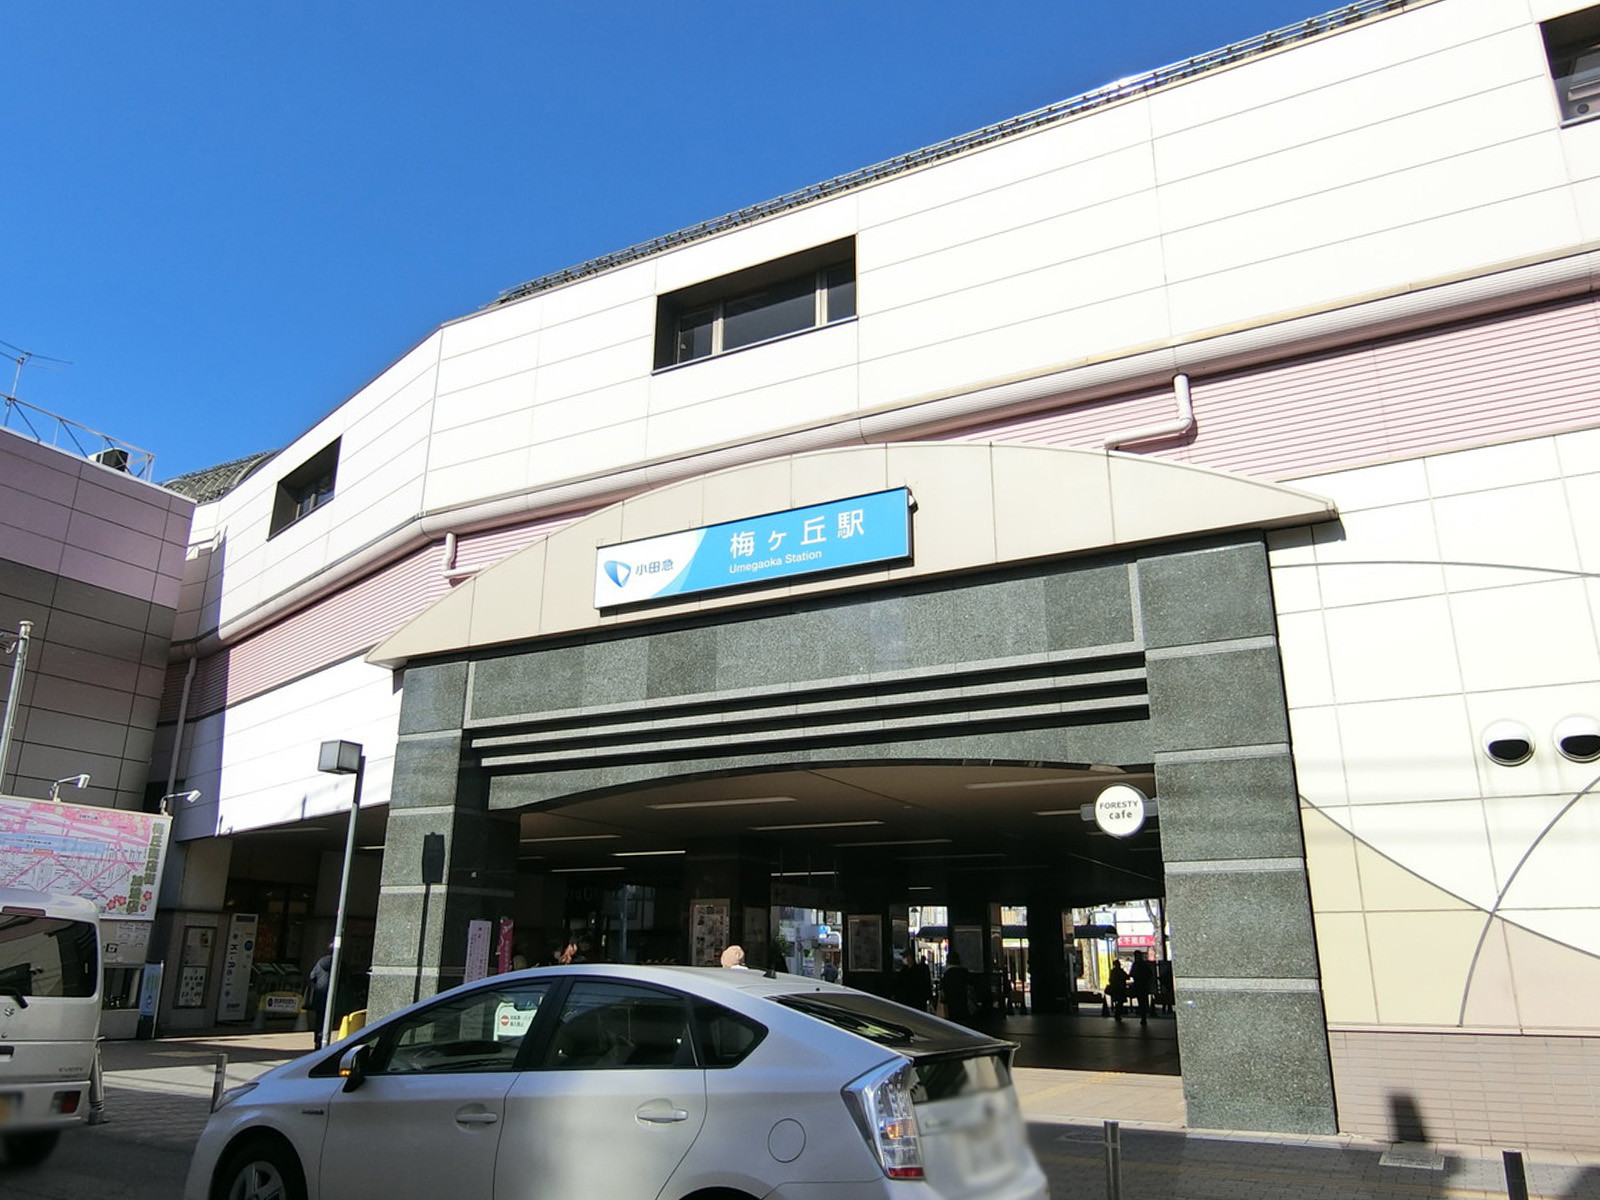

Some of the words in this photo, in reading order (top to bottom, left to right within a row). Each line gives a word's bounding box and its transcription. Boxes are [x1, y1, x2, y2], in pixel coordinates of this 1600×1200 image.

[635, 557, 674, 576] 小田急
[729, 556, 783, 574] Umegaoka
[784, 549, 823, 564] Station
[1099, 799, 1139, 810] FORESTY
[1108, 809, 1133, 820] cafe
